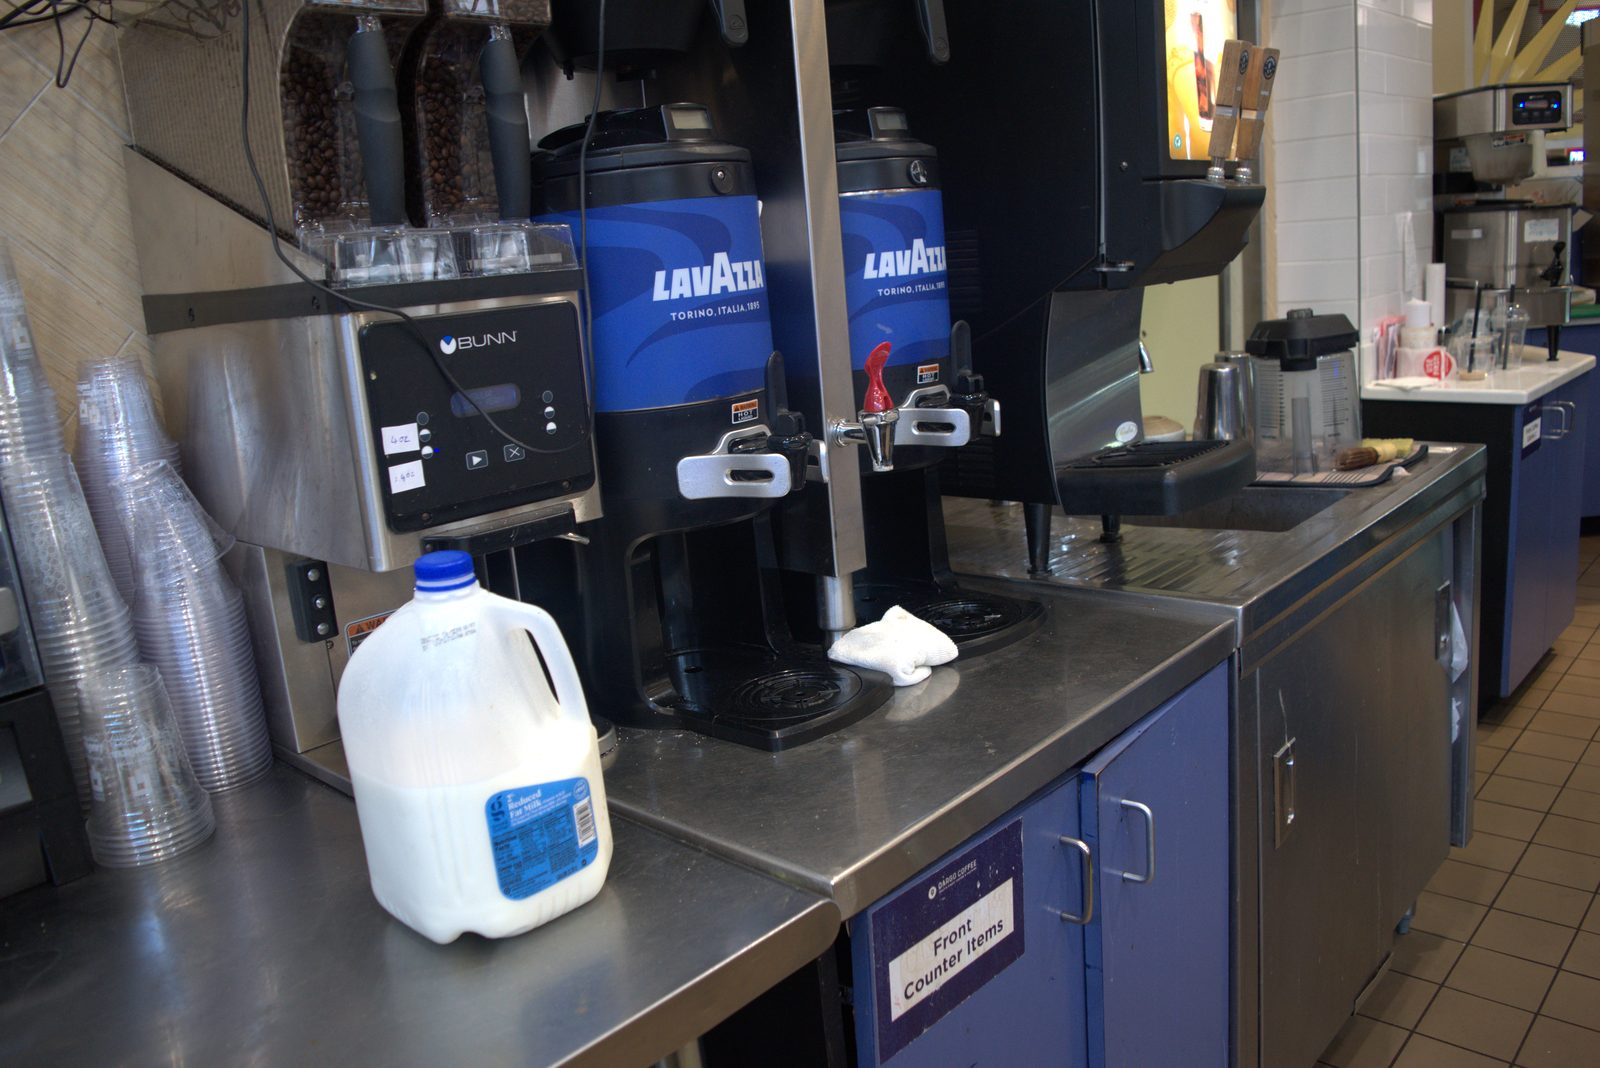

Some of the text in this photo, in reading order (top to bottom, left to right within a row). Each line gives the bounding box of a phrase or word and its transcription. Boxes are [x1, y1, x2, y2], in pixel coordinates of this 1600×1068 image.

[653, 252, 764, 301] LAVAZZA
[458, 331, 516, 349] BUNN
[508, 788, 542, 809] Reduced
[510, 807, 523, 818] Fat
[523, 799, 543, 813] Milk
[957, 859, 977, 877] COFFEE
[933, 918, 972, 957] Front
[903, 919, 1004, 1001] Counter Items
